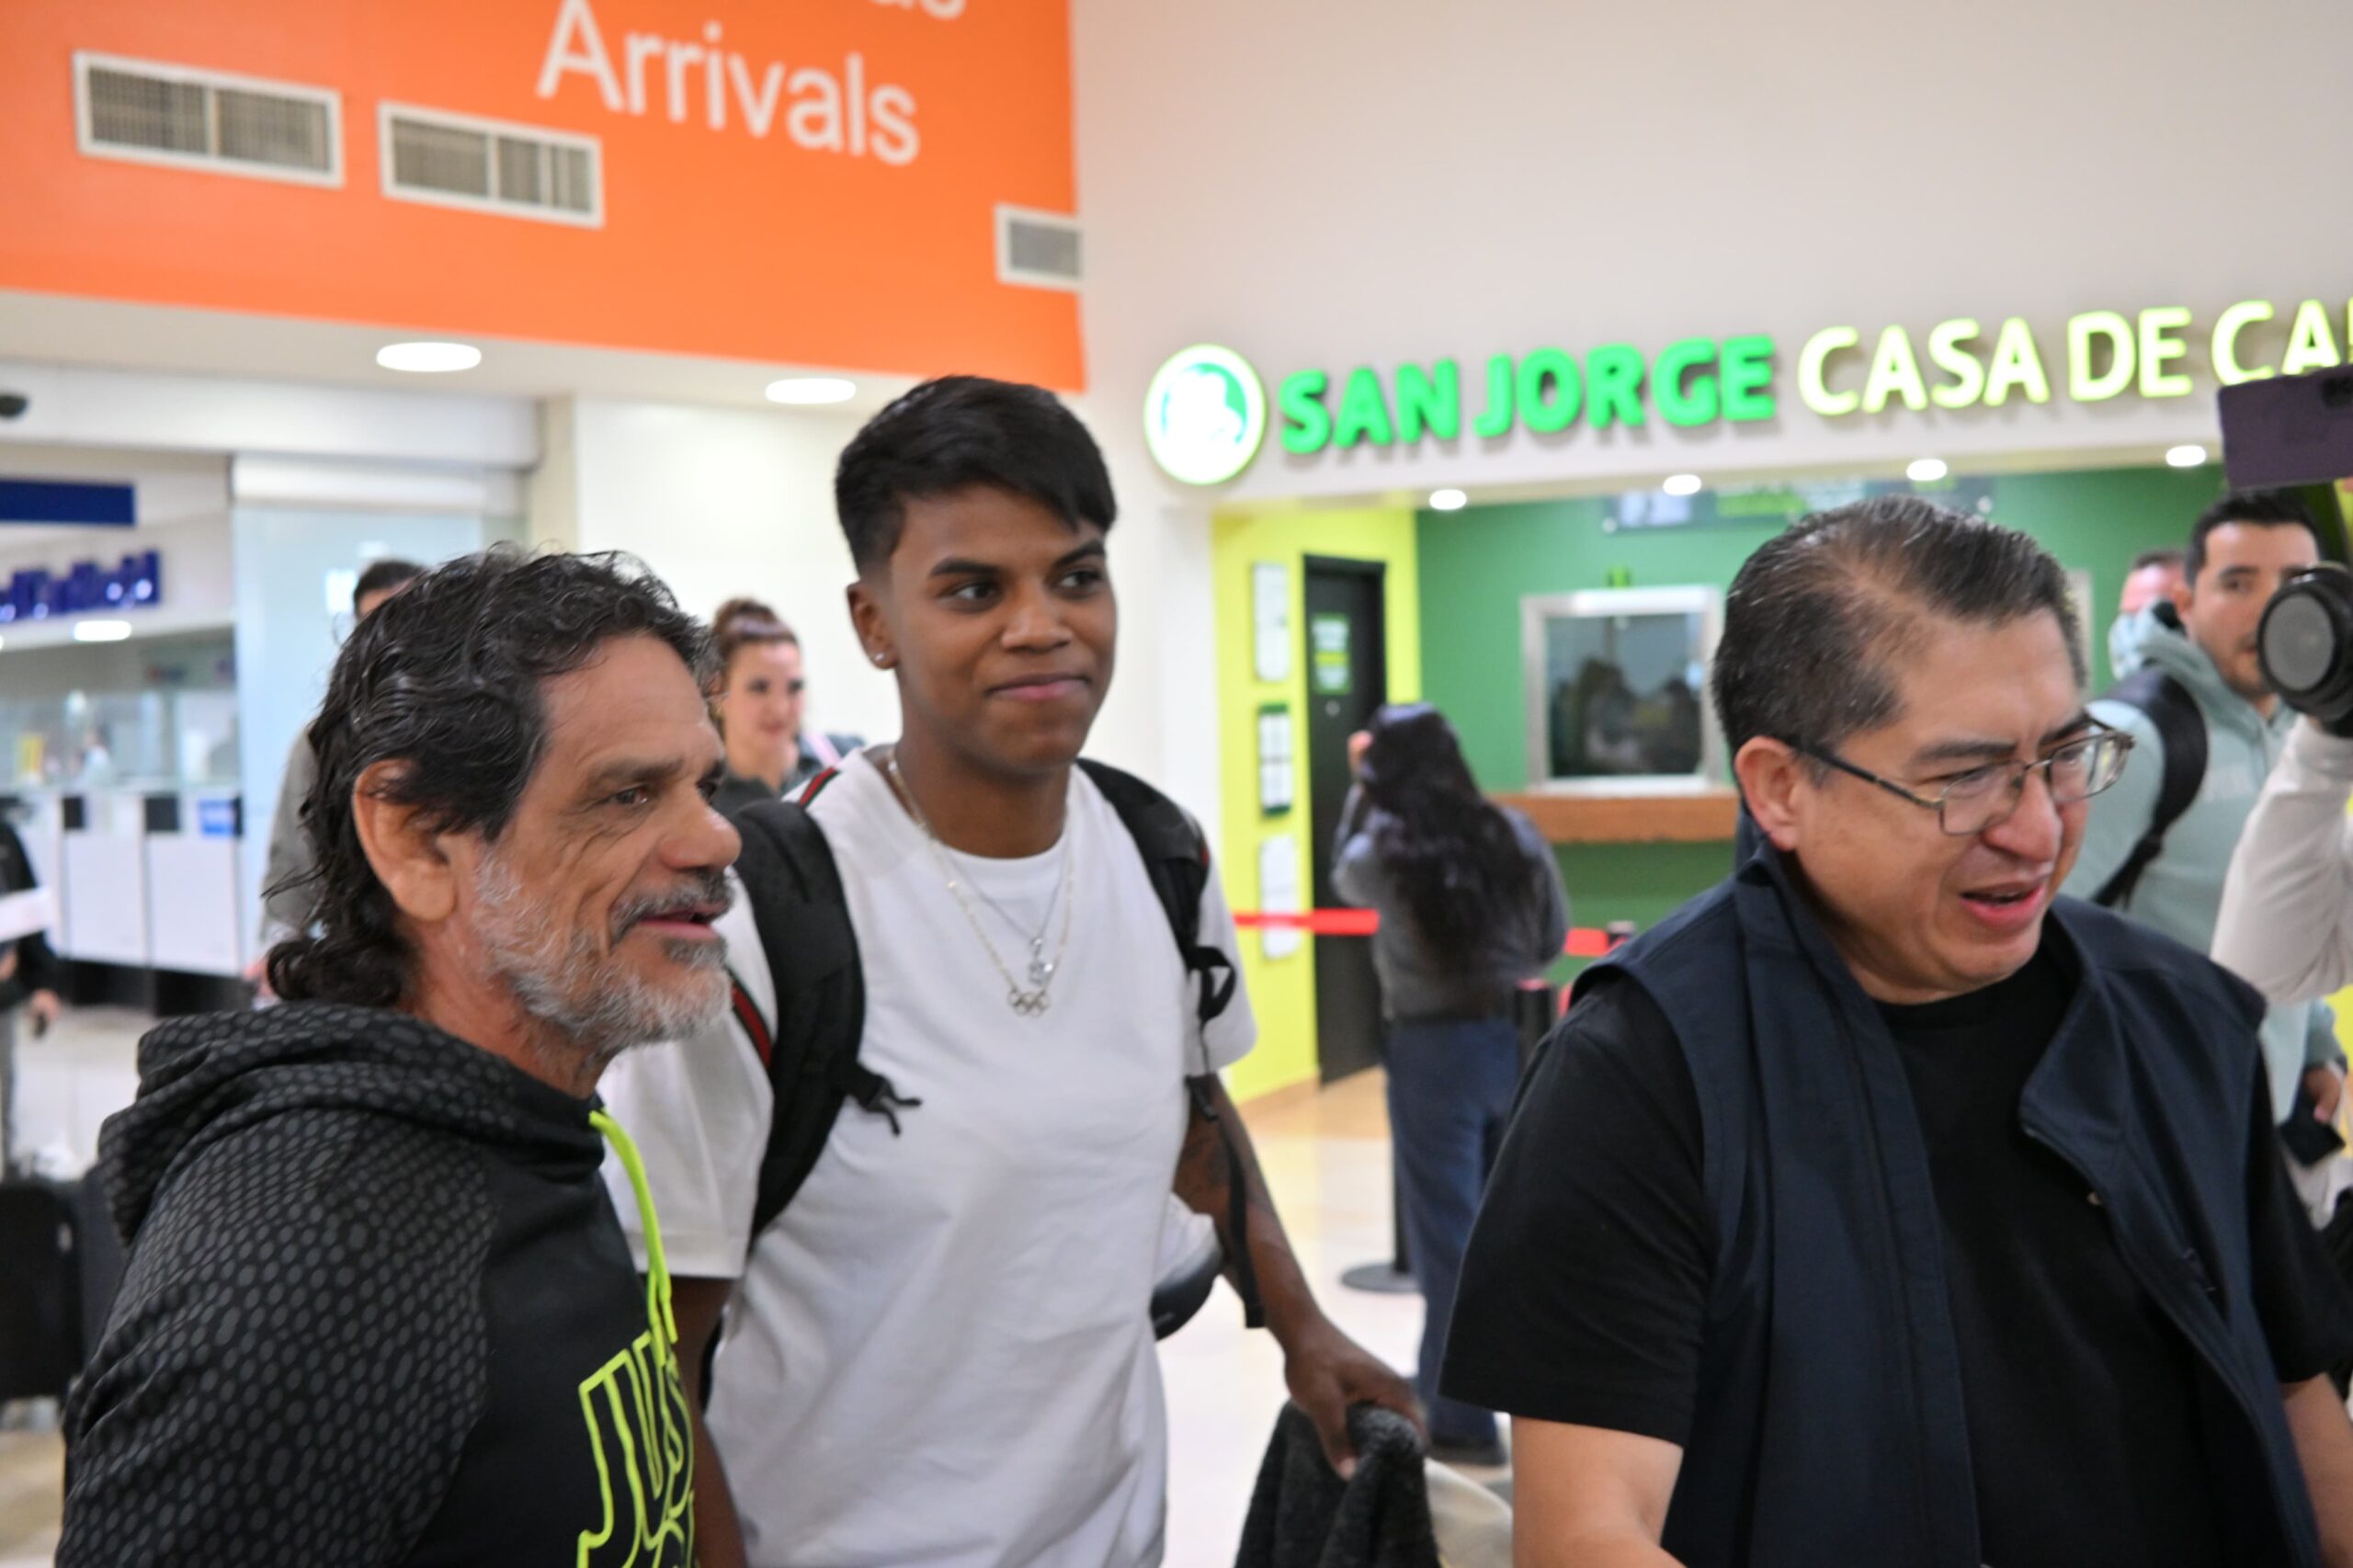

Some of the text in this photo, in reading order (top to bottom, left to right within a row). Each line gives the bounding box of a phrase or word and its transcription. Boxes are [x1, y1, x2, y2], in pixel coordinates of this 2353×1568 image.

[536, 0, 920, 165] Arrivals
[1279, 297, 2353, 454] SAN JORGE CASA DE CA
